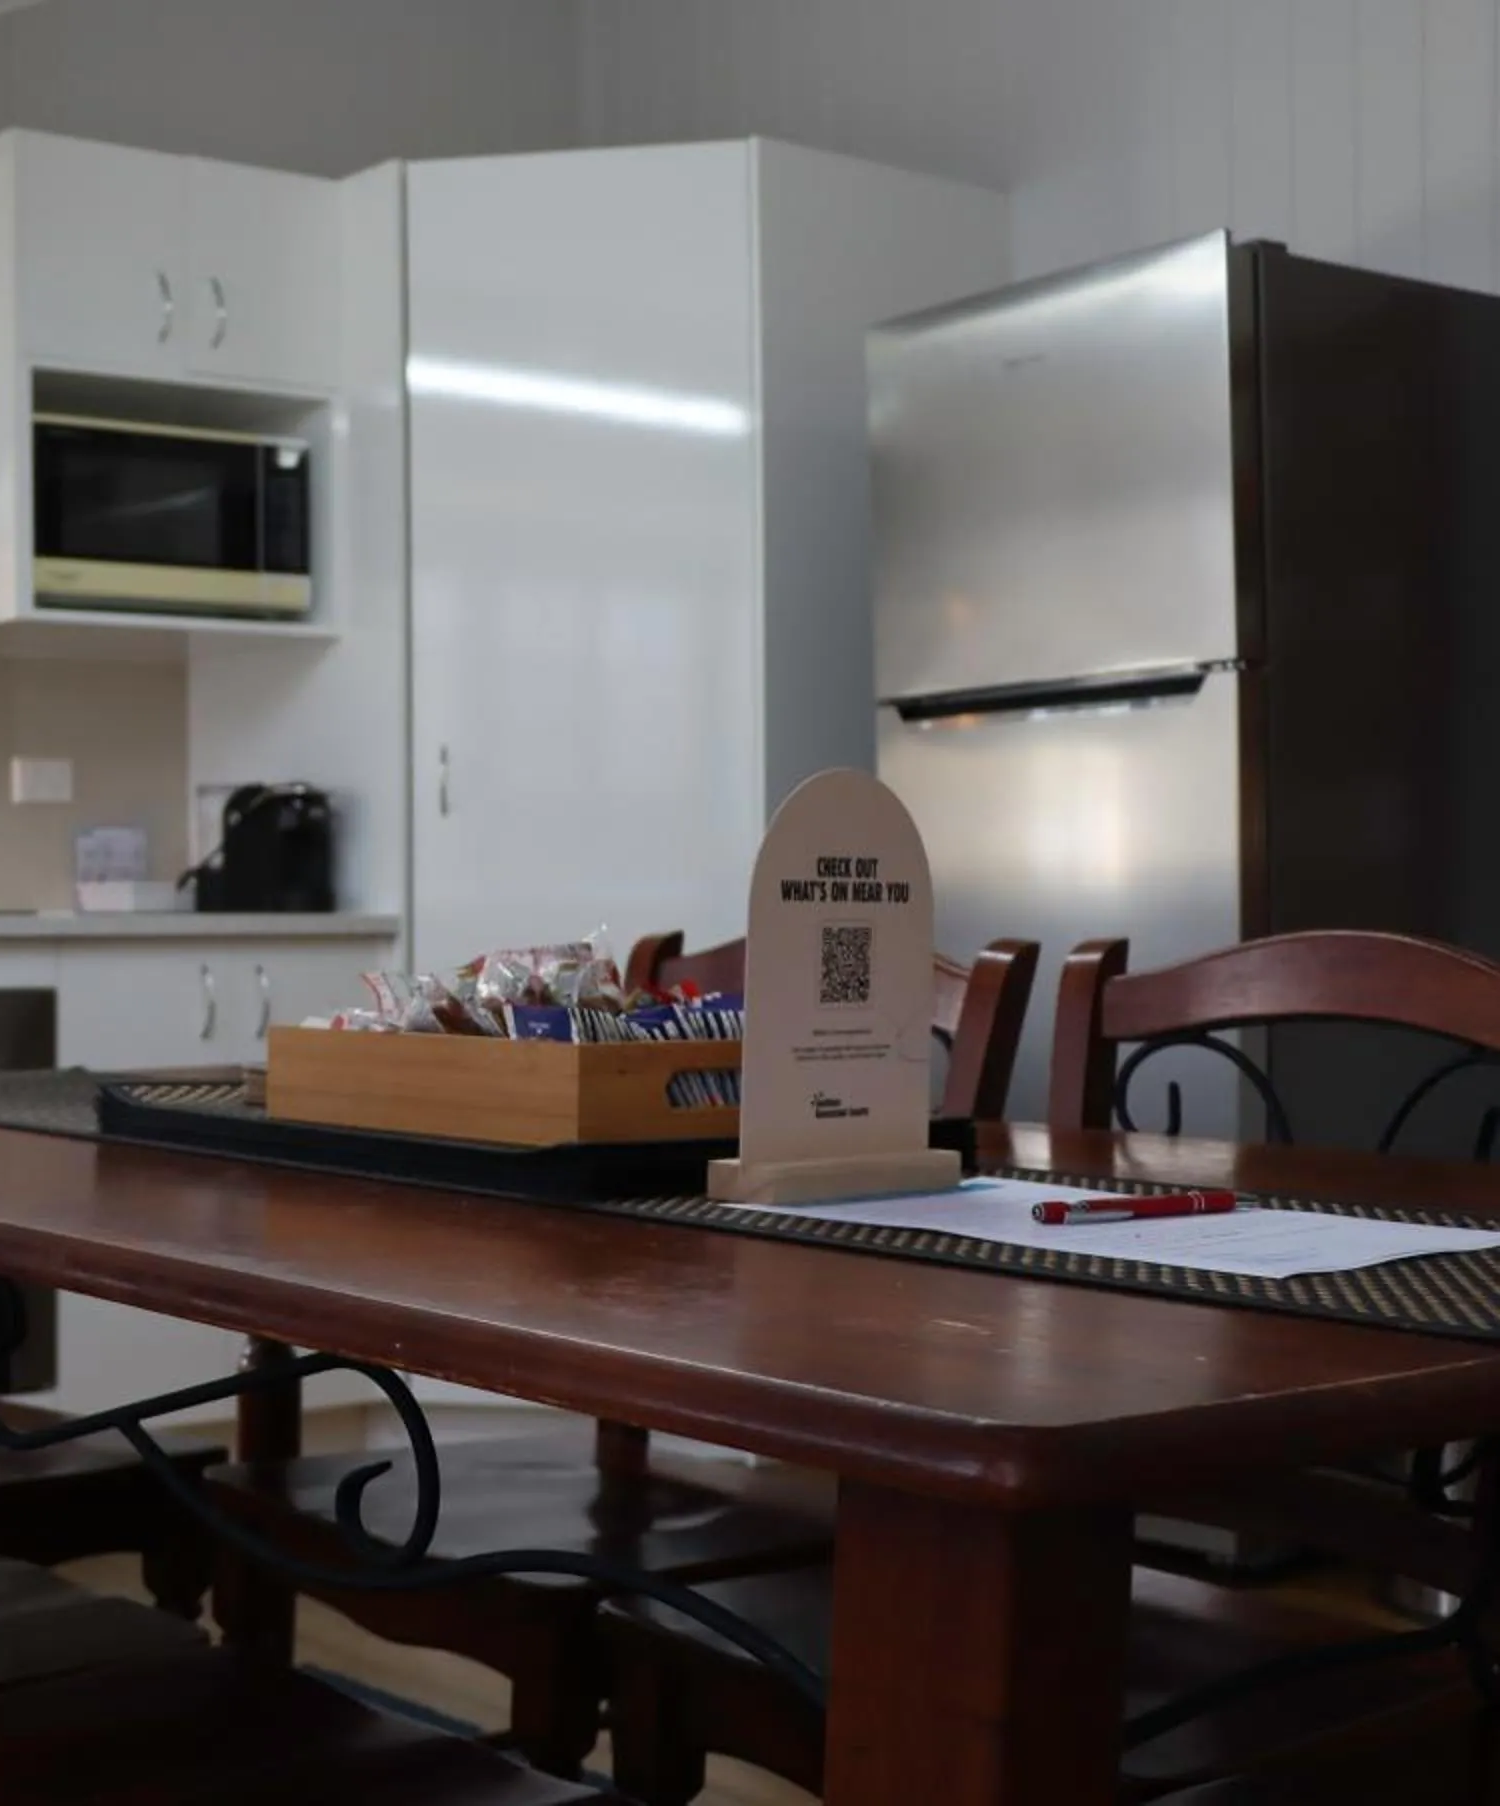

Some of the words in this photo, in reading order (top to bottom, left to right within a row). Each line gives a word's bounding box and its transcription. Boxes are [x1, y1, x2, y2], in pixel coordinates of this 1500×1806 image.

[817, 856, 852, 878] CHECK
[855, 857, 879, 879] OUT
[781, 879, 827, 902] WHAT'S
[831, 881, 849, 902] ON
[852, 881, 883, 902] NEAR
[886, 881, 909, 903] YOU
